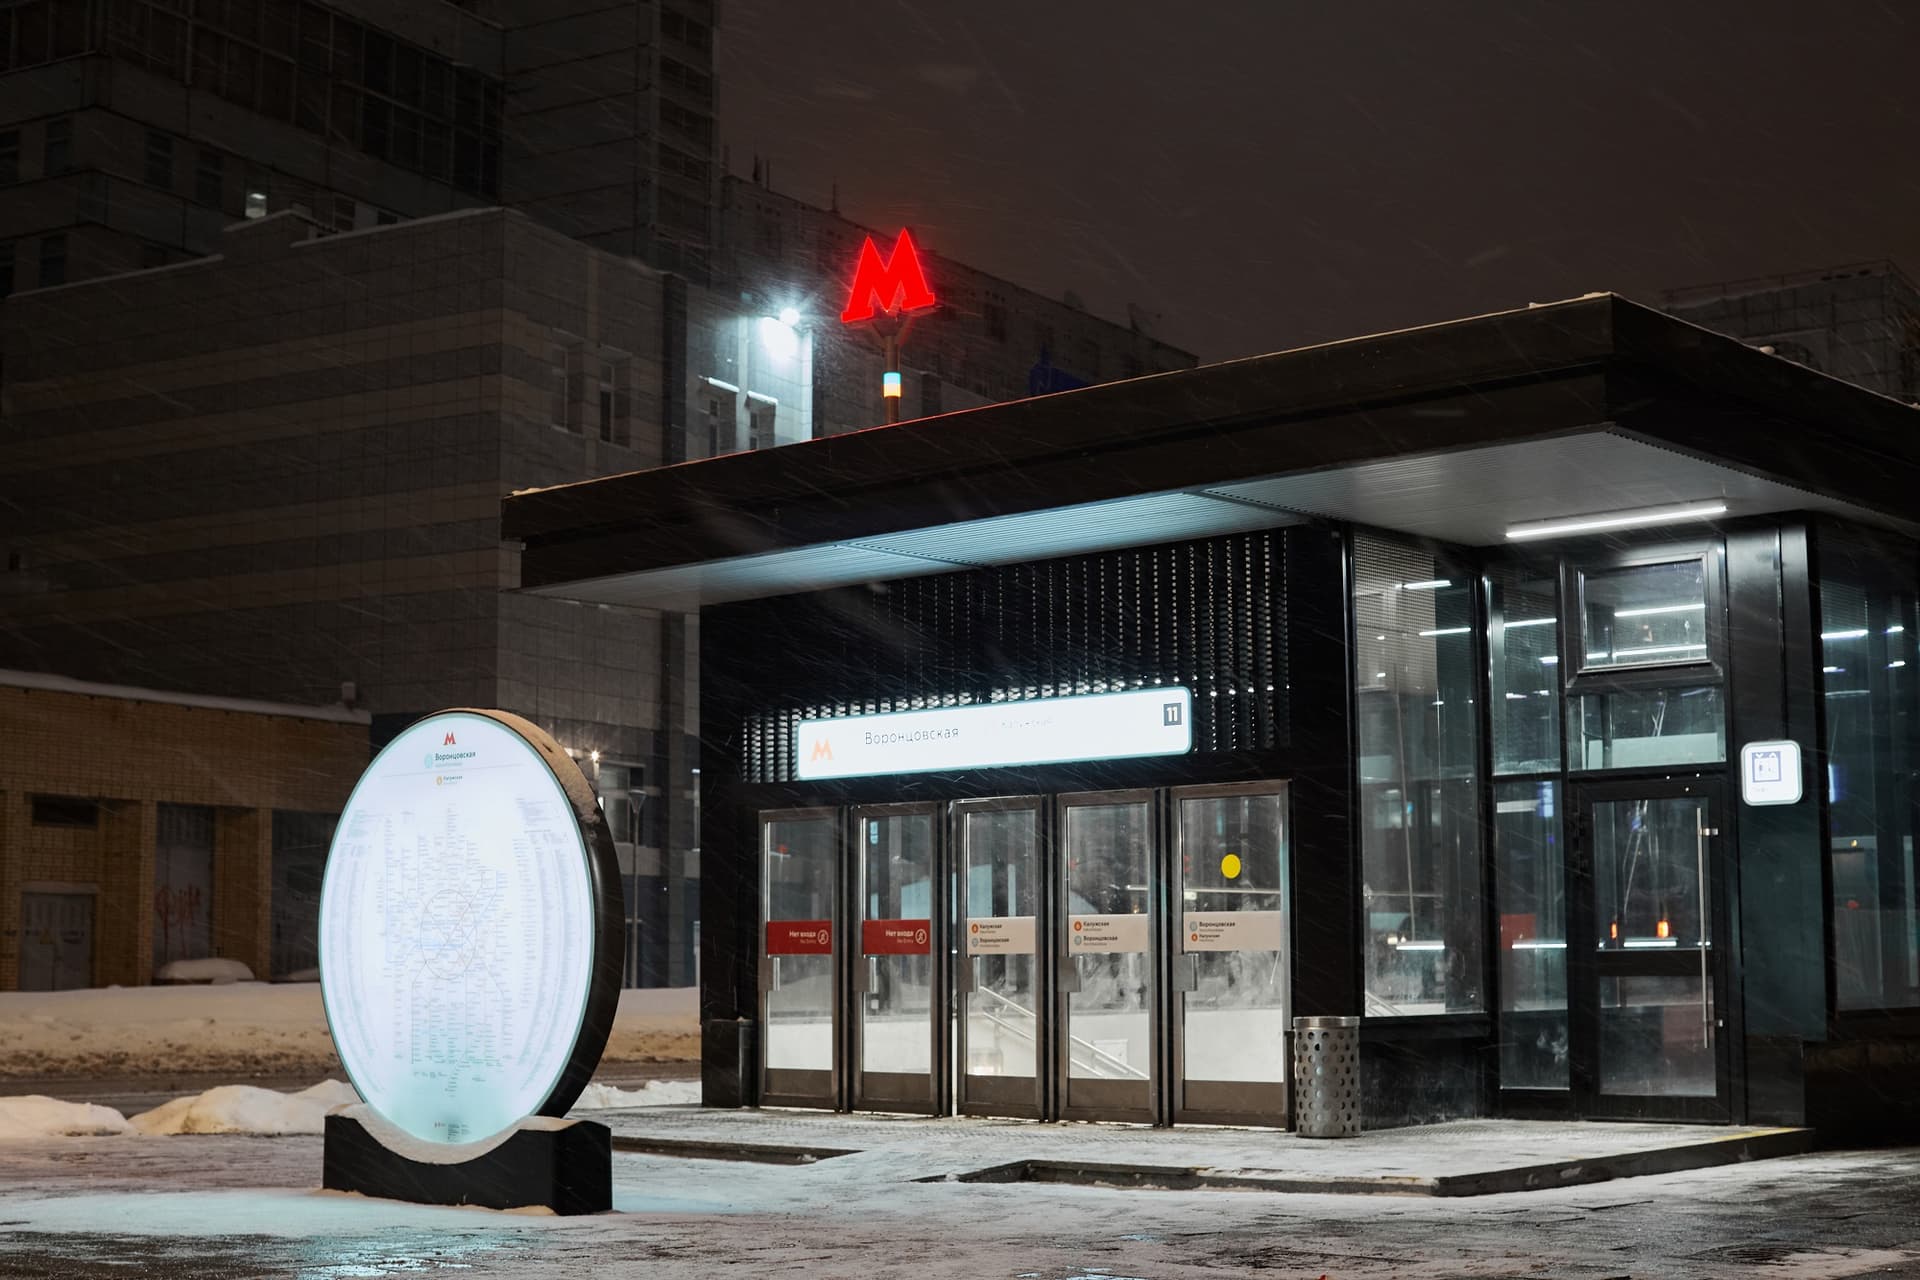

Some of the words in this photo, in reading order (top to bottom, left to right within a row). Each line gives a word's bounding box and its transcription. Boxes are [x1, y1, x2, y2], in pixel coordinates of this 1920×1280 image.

[840, 227, 936, 323] М
[443, 732, 456, 746] М
[864, 727, 960, 746] Воронцовская
[435, 752, 476, 761] Воронцовская
[810, 738, 834, 762] М
[789, 930, 800, 938] Нет
[800, 930, 816, 938] входа
[885, 929, 896, 937] Нет
[896, 929, 914, 937] входа
